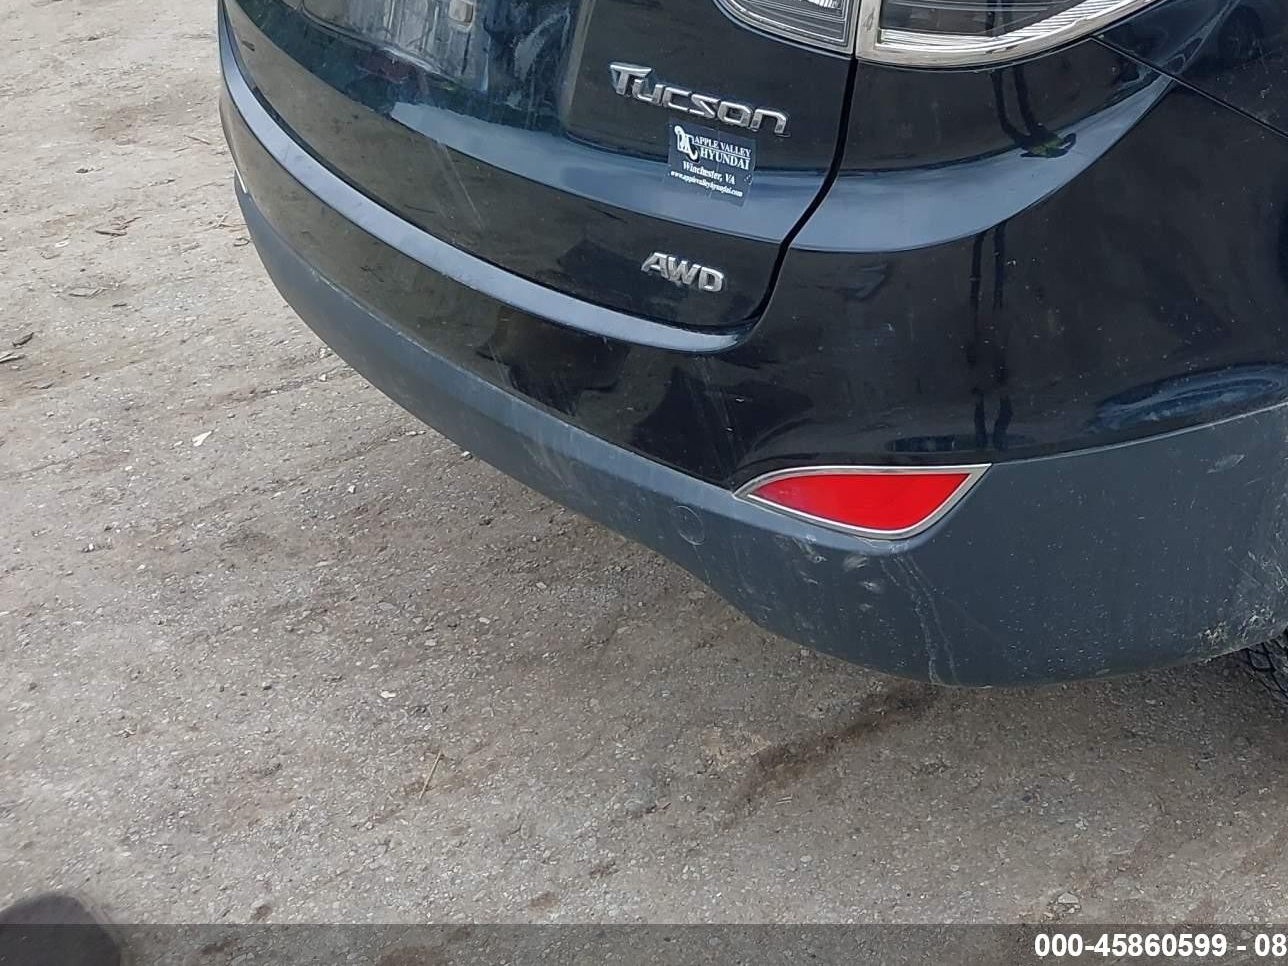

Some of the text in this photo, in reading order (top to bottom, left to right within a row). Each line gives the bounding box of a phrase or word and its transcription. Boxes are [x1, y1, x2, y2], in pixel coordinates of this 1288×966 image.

[694, 136, 719, 149] APPLE
[720, 141, 752, 158] VALLEY
[700, 147, 750, 171] HYUNDAI
[683, 160, 736, 185] Winchester, VA
[641, 252, 725, 292] AWD
